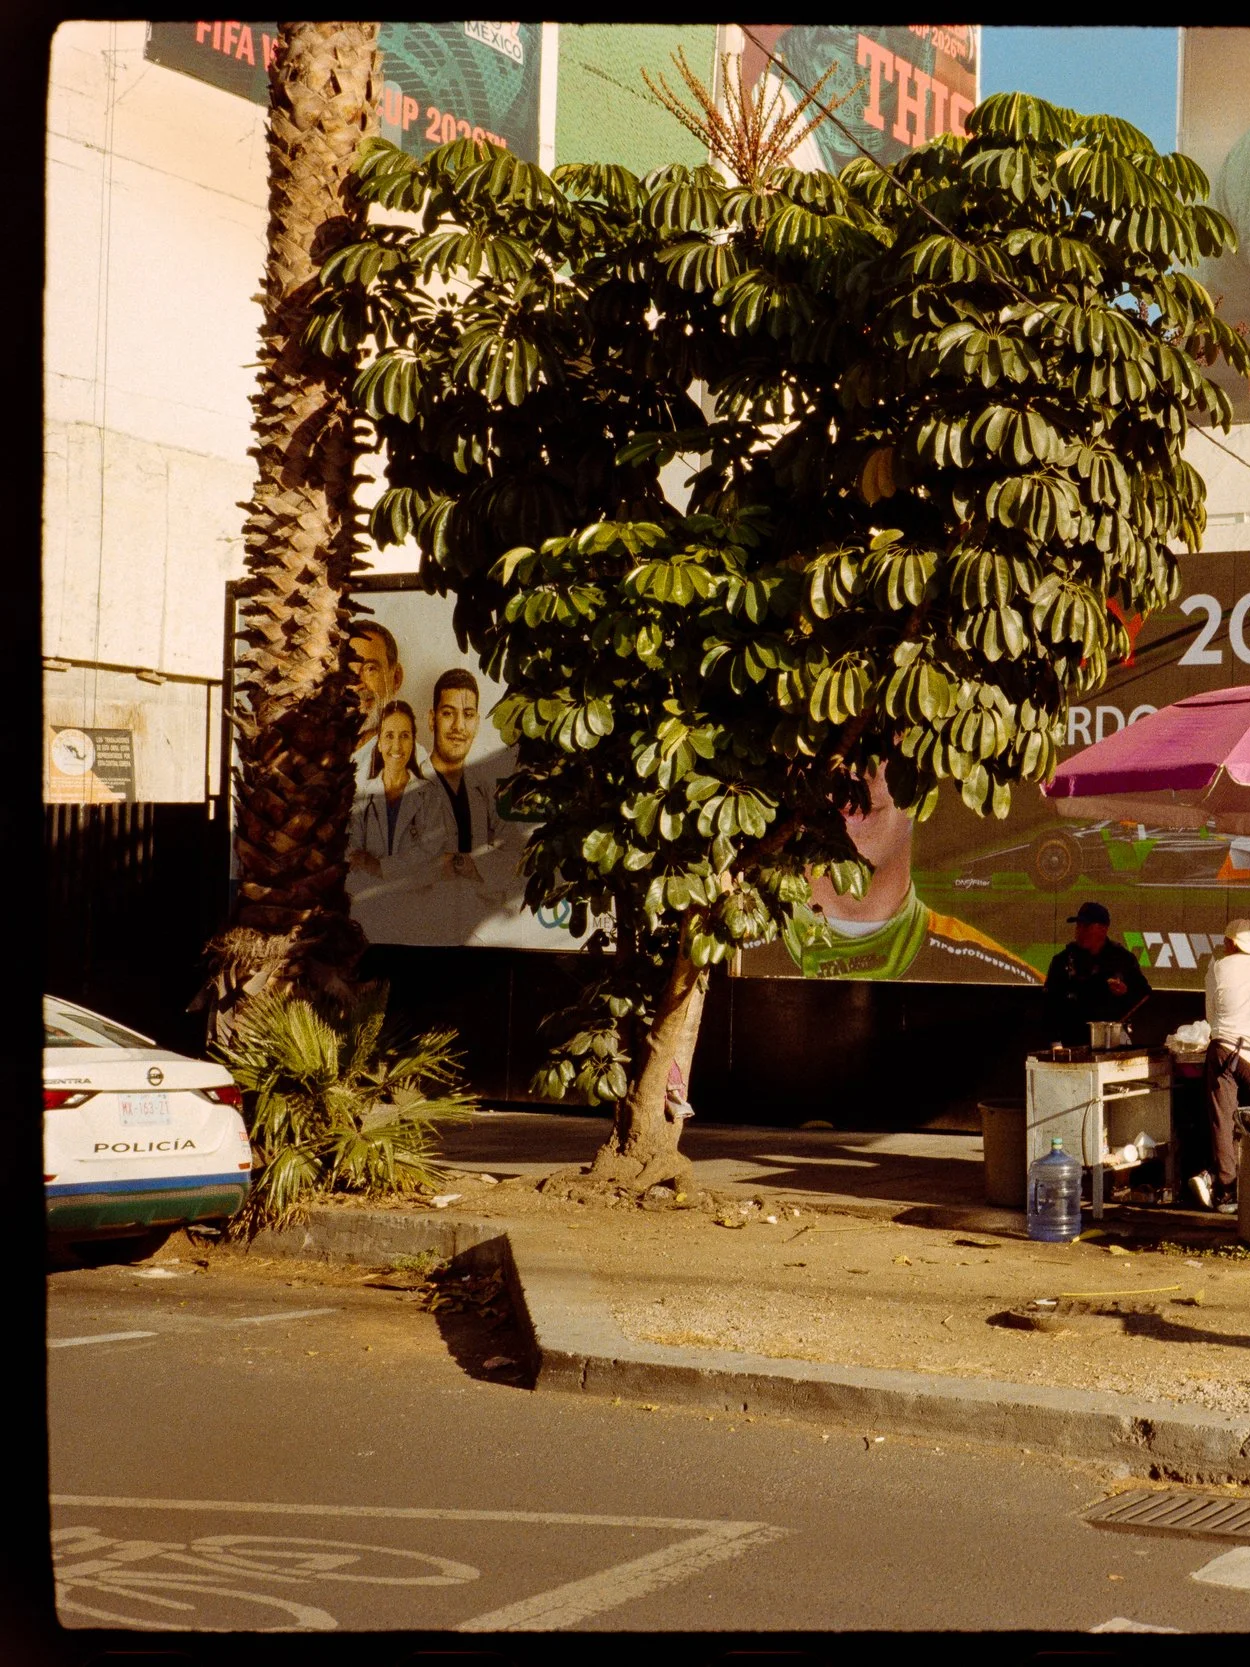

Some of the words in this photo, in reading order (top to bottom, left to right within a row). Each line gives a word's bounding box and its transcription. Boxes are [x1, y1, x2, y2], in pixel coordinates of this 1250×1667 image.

[195, 21, 256, 67] FIFA
[376, 87, 419, 132] UP
[93, 1138, 197, 1153] POLICÍA
